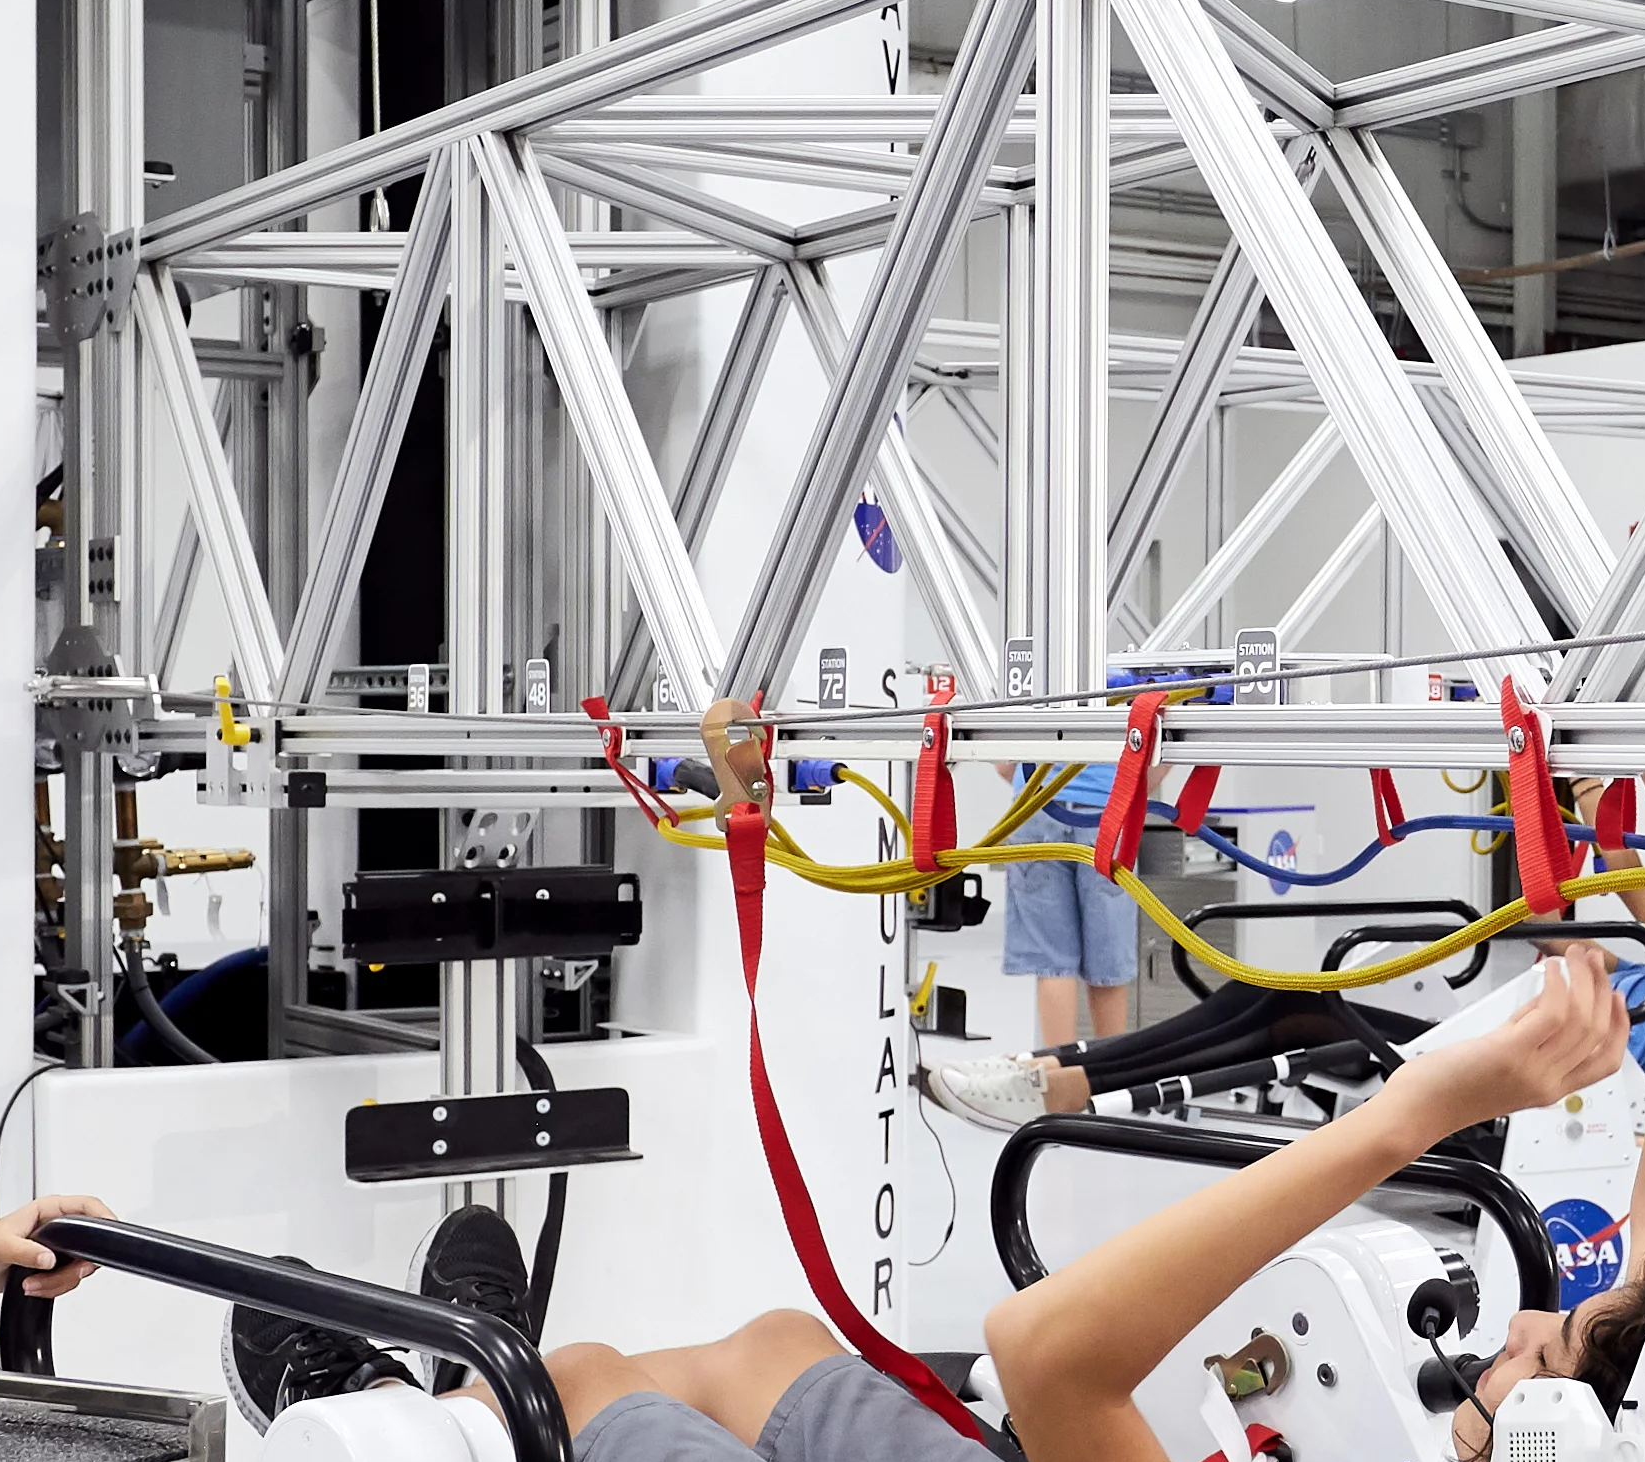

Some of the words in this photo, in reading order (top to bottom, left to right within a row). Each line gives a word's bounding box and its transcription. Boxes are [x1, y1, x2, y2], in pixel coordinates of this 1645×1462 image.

[1008, 651, 1032, 663] STATIO
[1238, 643, 1275, 656] STATION
[821, 658, 845, 670] STATION
[822, 673, 844, 700] 72
[932, 676, 950, 691] 12
[1008, 667, 1033, 697] 84
[1239, 661, 1274, 694] 96
[409, 686, 425, 708] 36
[528, 682, 546, 706] 48
[1556, 1239, 1619, 1267] ASA
